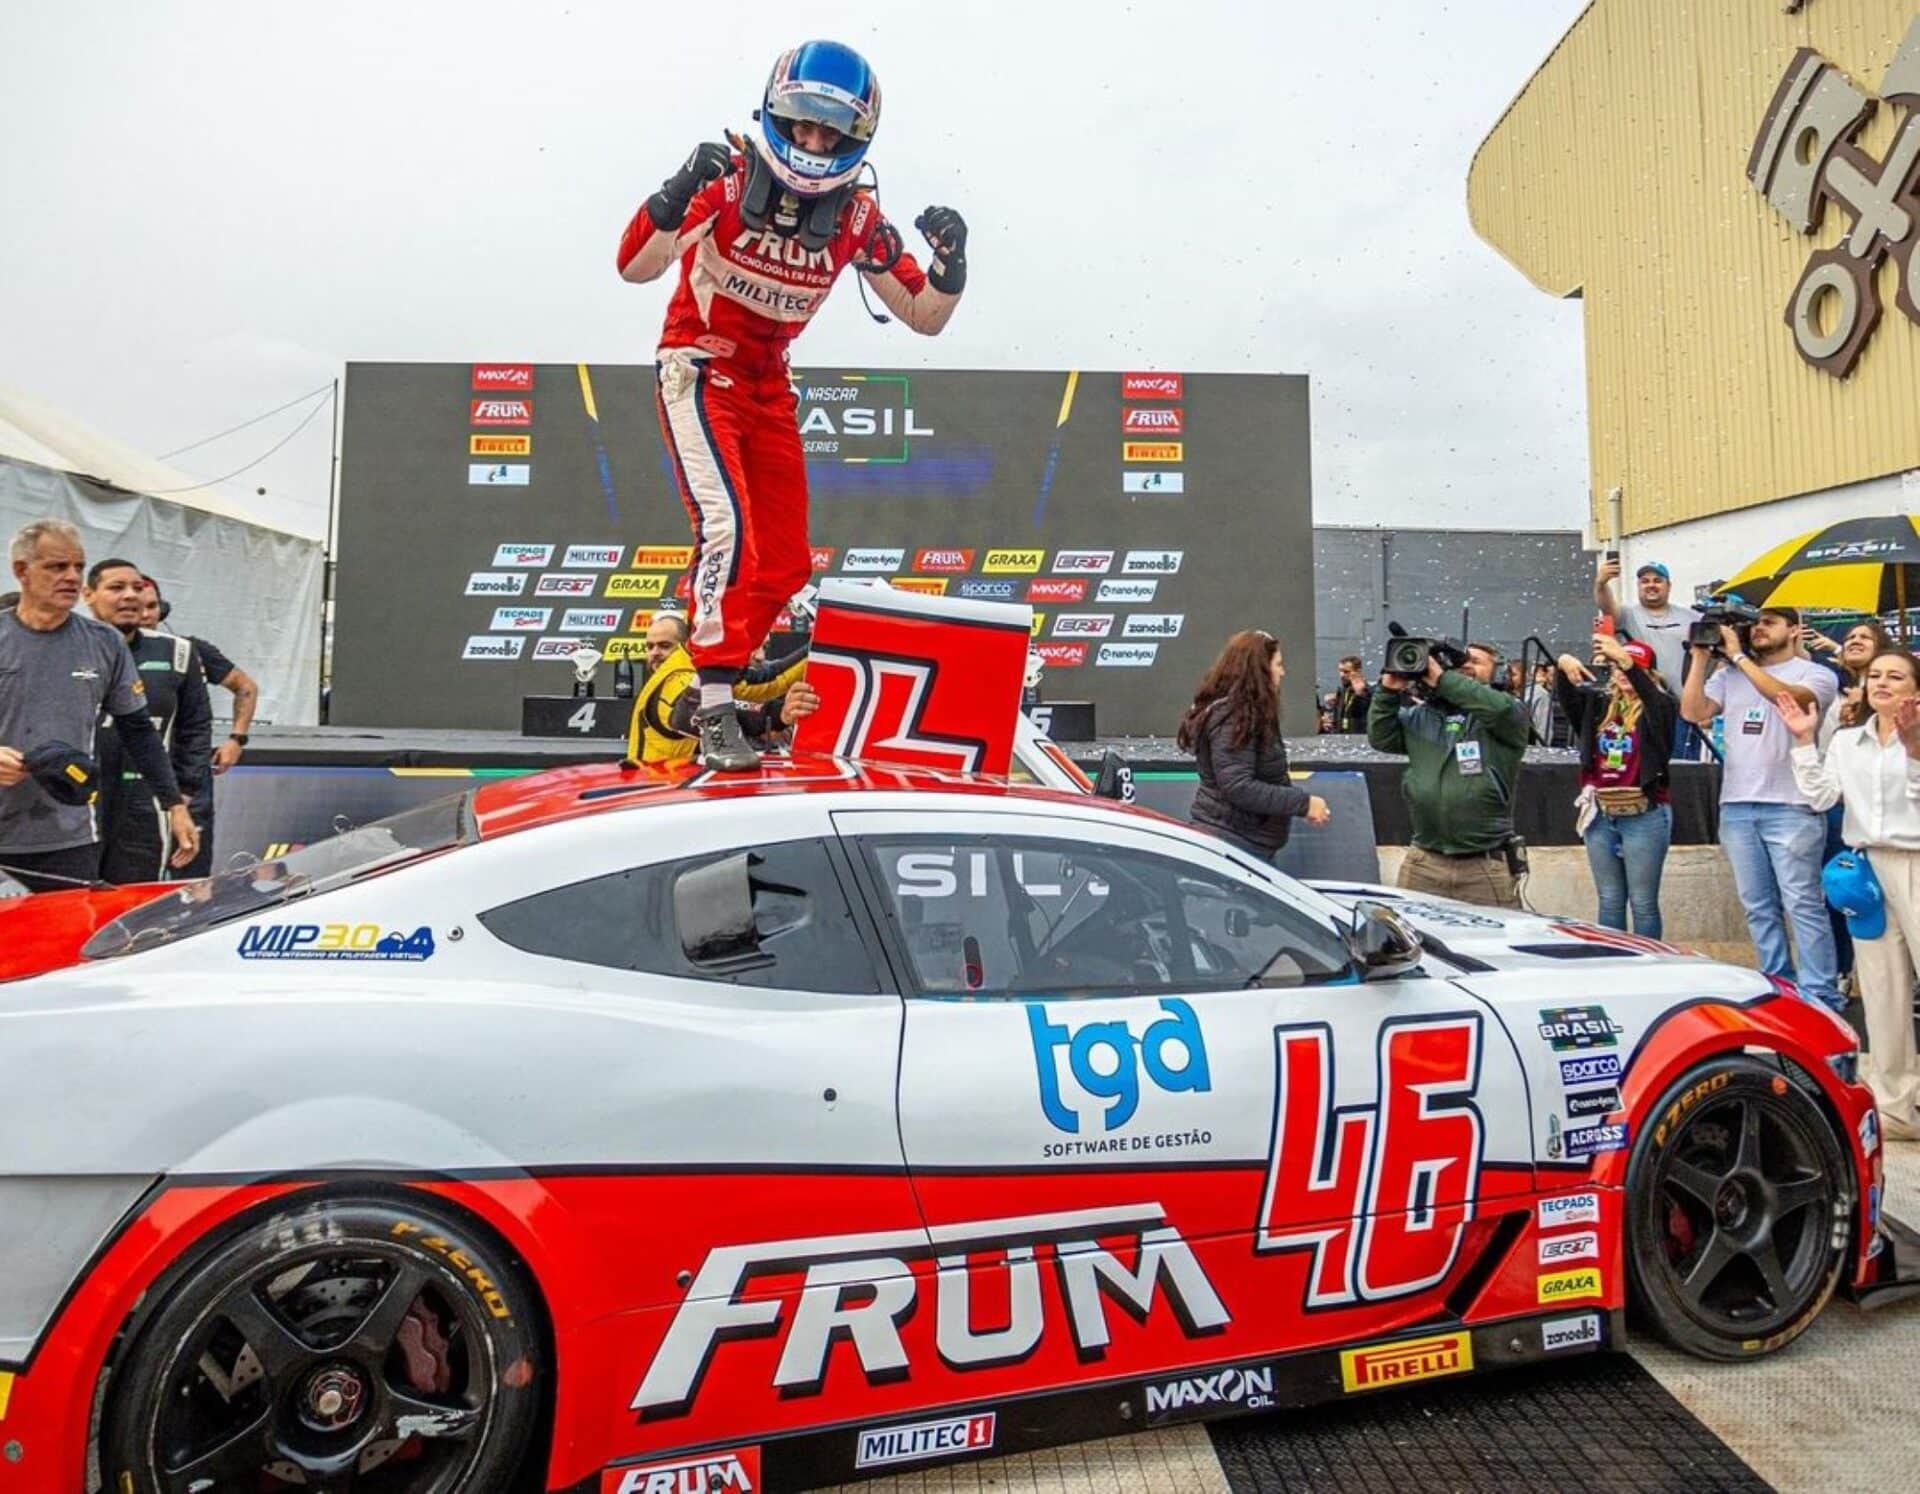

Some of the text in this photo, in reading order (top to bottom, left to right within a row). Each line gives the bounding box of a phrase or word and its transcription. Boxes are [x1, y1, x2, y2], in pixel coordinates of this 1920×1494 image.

[805, 387, 859, 401] NASCAR
[475, 401, 529, 417] FRUM
[1127, 410, 1180, 426] FRUM
[802, 441, 840, 453] SERIES
[502, 547, 546, 555] TECPADS
[921, 551, 966, 565] FRUM
[988, 554, 1038, 566] GRAXA
[610, 578, 661, 590] GRAXA
[568, 702, 597, 732] 4
[1540, 1018, 1624, 1039] BRASIL
[1562, 1058, 1618, 1079] sparco
[1043, 1128, 1212, 1158] SOFTWARE DE GESTÃO
[1570, 1125, 1623, 1147] ACROSS
[1253, 1010, 1485, 1315] 46
[1541, 1195, 1595, 1213] TECPADS
[1542, 1275, 1595, 1295] GRAXA
[630, 1201, 1232, 1409] FRUM
[1354, 1338, 1459, 1386] PIRELLI
[1145, 1366, 1274, 1413] MAXON
[1246, 1391, 1275, 1409] OIL
[616, 1454, 752, 1494] FRUM
